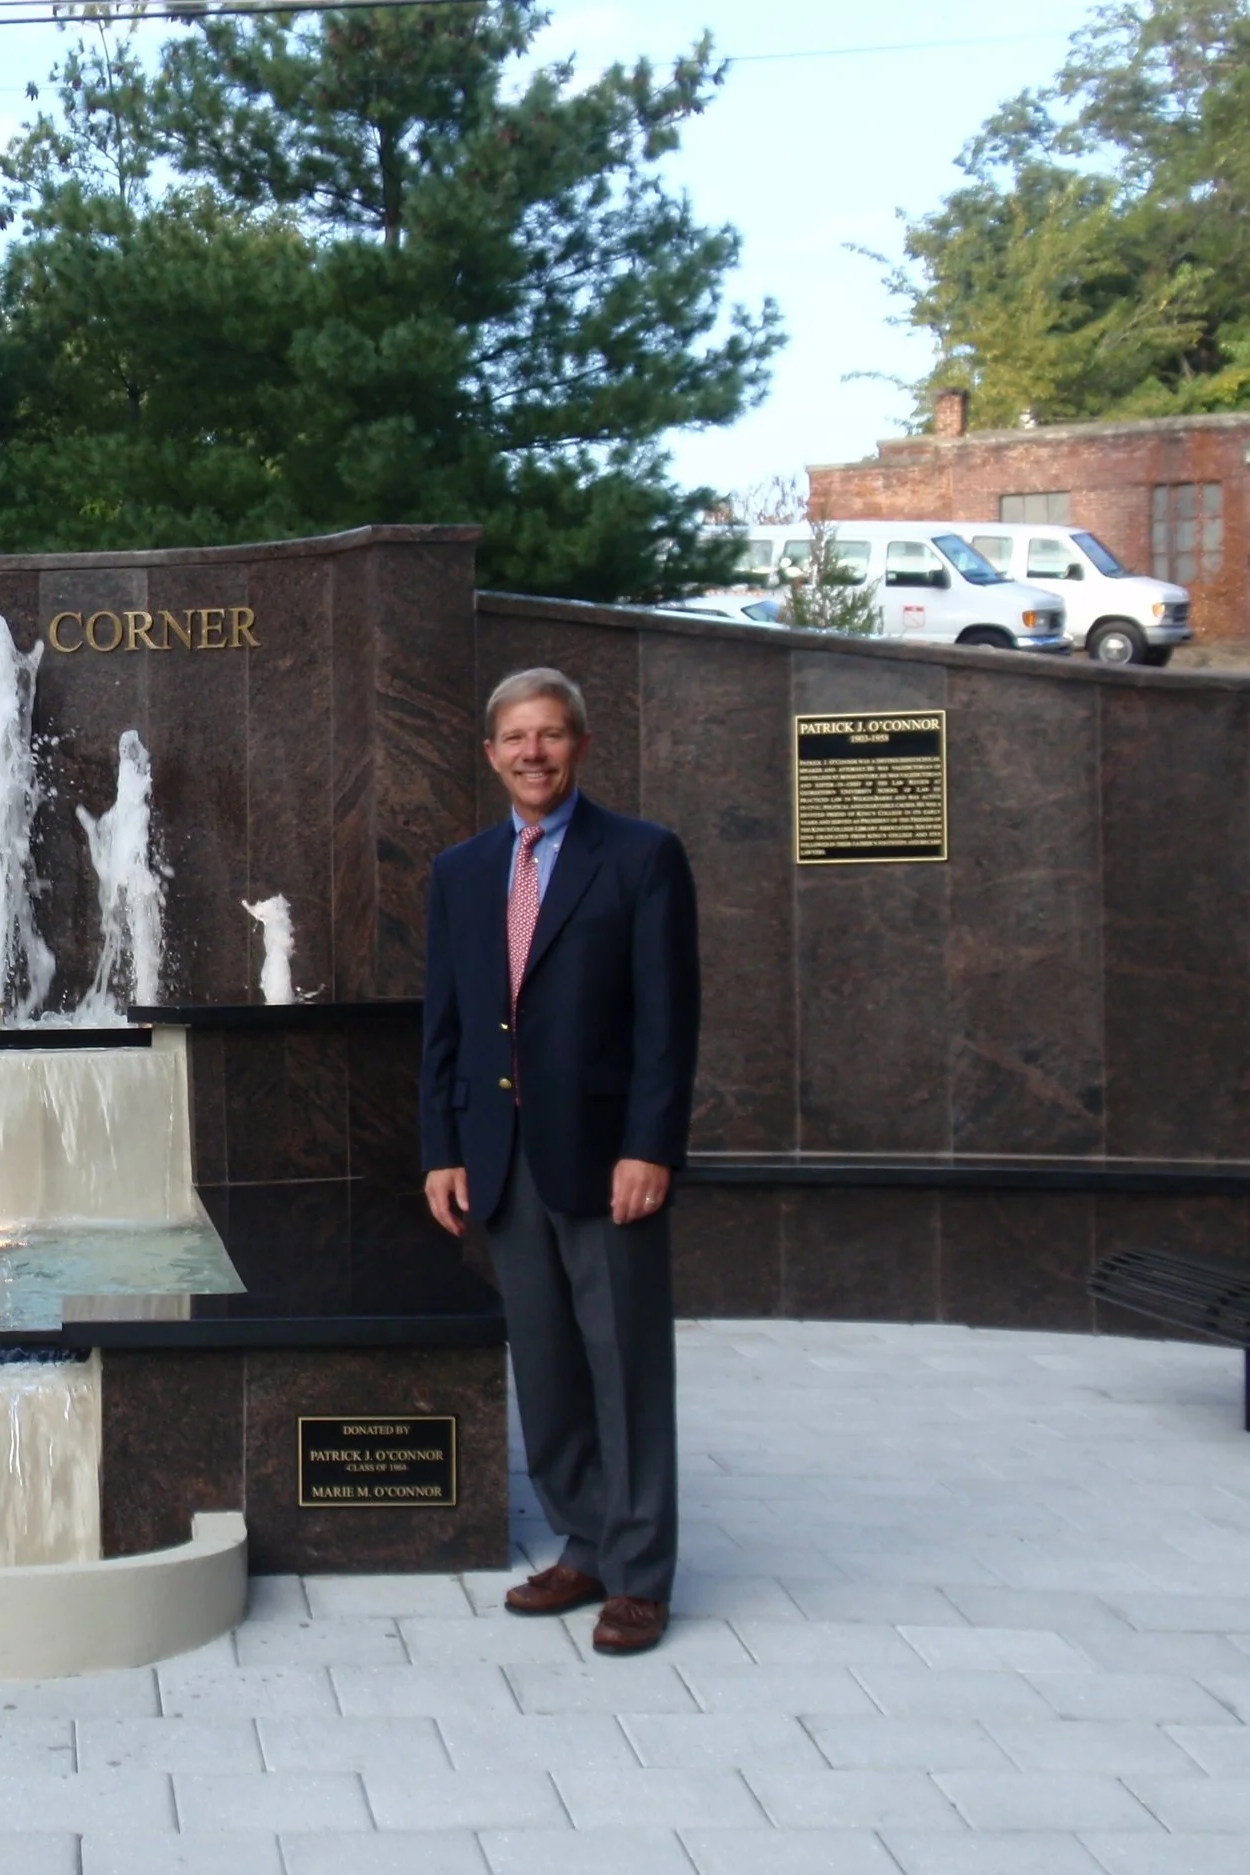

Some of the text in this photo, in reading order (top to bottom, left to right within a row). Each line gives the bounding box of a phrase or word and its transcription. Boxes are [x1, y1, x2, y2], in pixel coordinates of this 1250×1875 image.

[49, 607, 261, 652] CORNER
[800, 719, 940, 734] PATRICK J. O'CONNOR
[343, 1425, 410, 1435] DONATED BY
[310, 1450, 444, 1461] PATRICK J. O'CONNOR
[376, 1463, 387, 1472] OF
[312, 1486, 442, 1498] MARIE M. O'CONNOR
